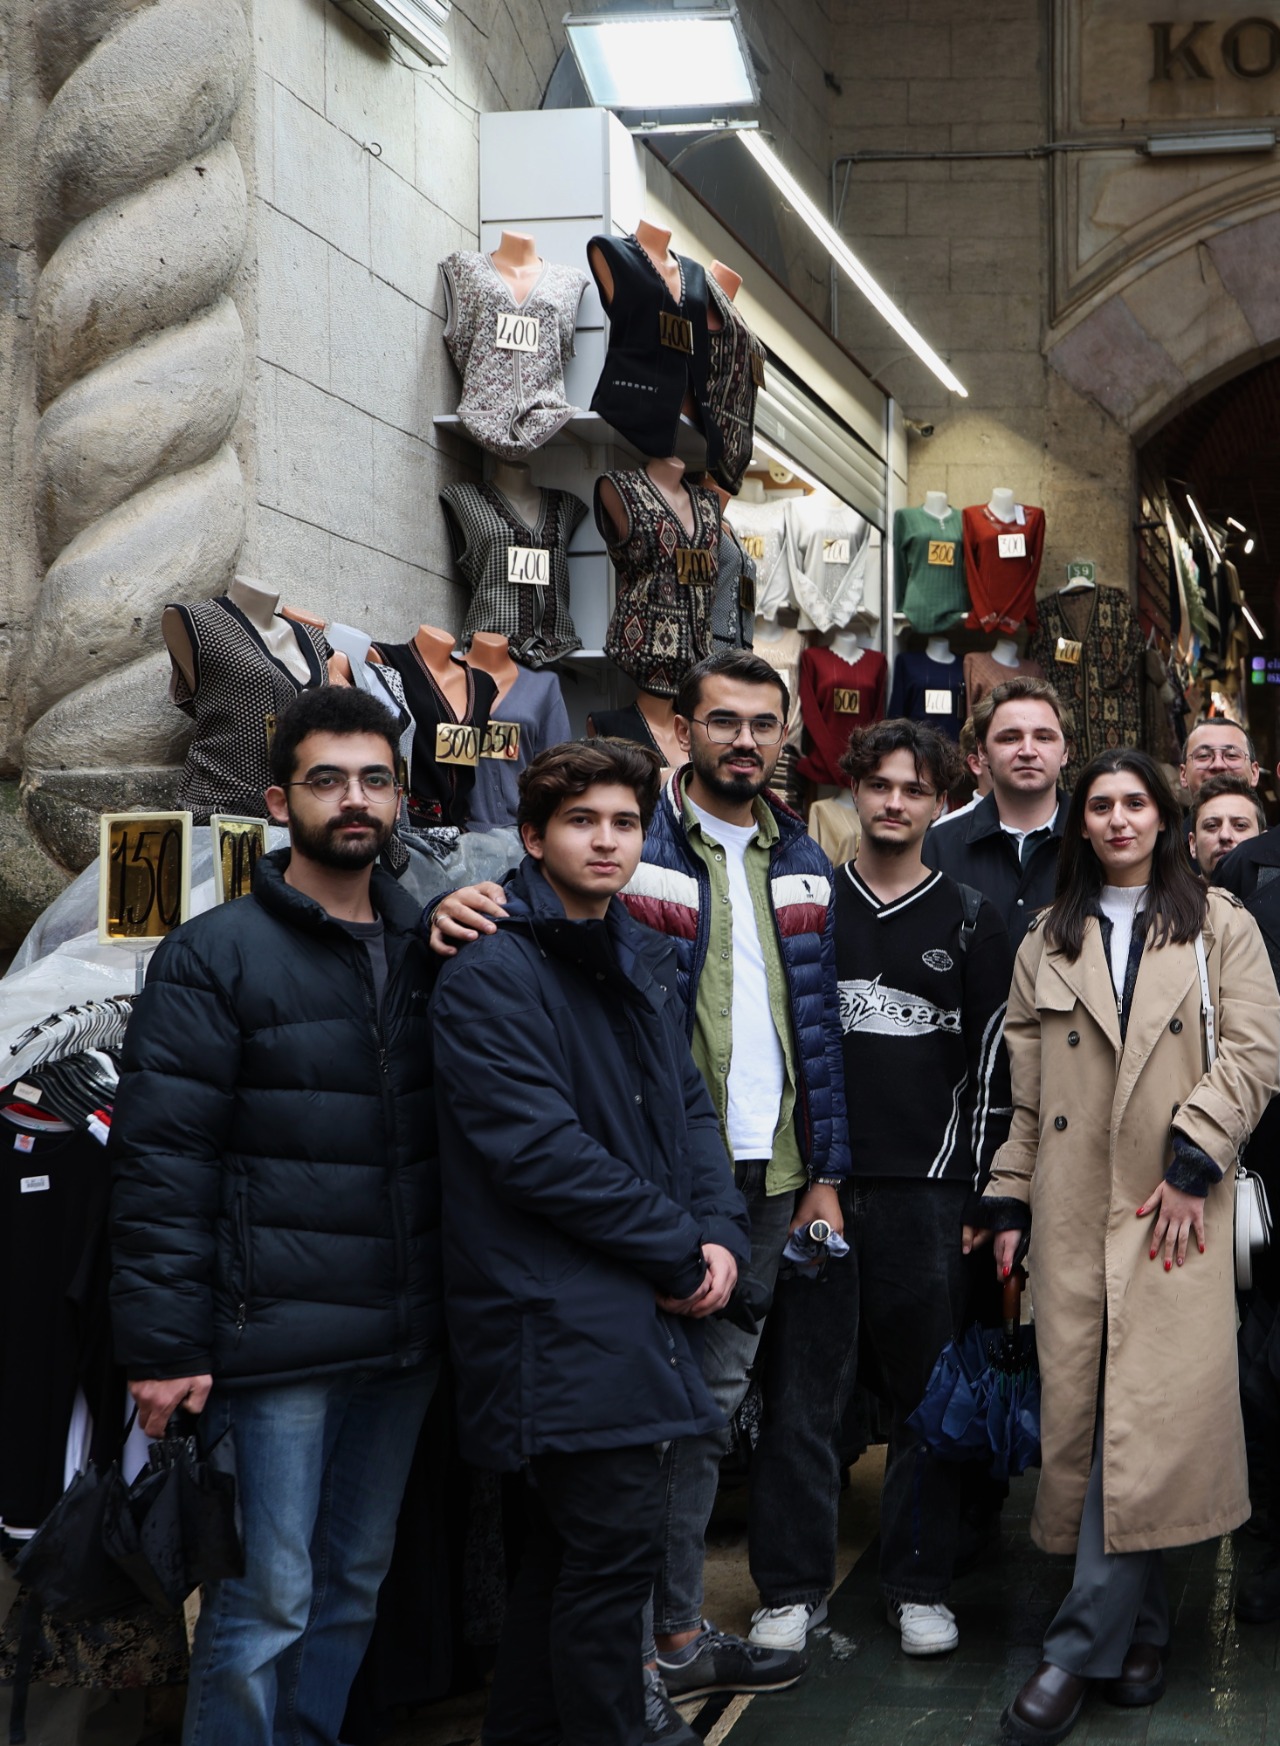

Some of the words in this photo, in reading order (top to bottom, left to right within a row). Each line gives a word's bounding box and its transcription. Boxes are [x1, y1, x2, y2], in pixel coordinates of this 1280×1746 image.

[498, 316, 537, 347] 400
[661, 314, 690, 350] 400
[510, 550, 548, 582] 400
[678, 551, 709, 583] 400
[930, 543, 954, 563] 300
[436, 726, 477, 760] 300
[111, 828, 182, 926] 150
